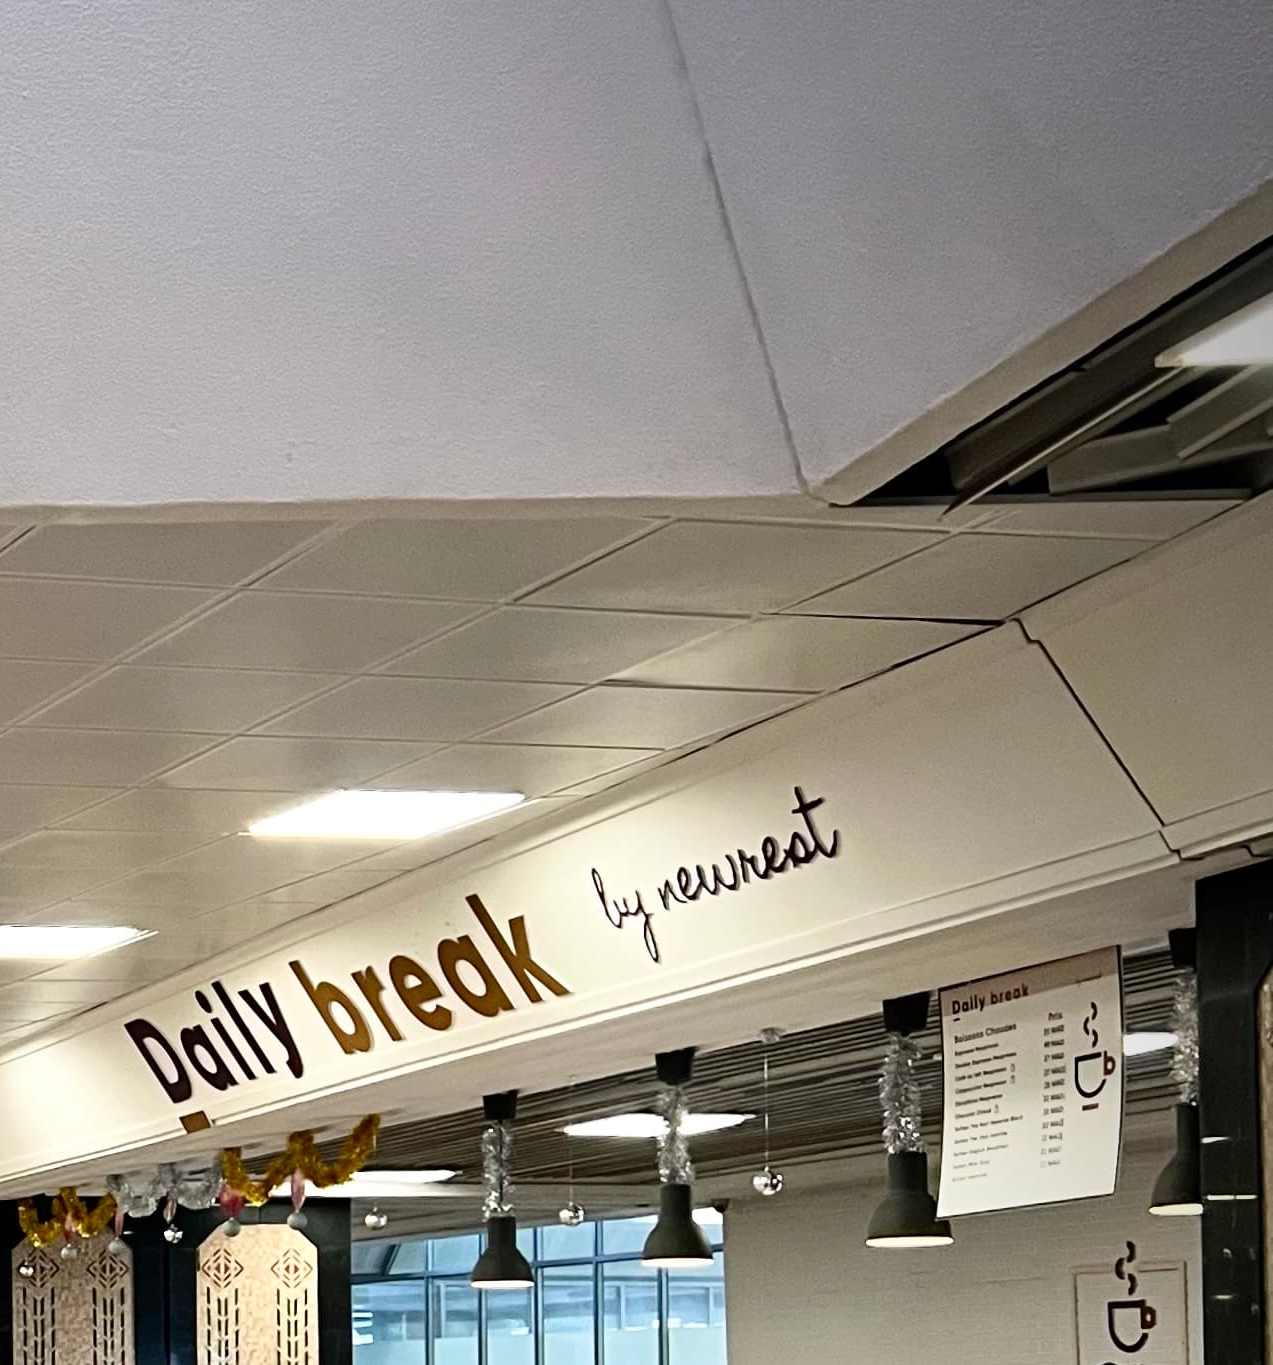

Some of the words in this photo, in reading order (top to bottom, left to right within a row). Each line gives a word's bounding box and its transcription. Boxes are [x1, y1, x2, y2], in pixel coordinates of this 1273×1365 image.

[591, 868, 661, 963] by
[658, 786, 842, 910] newrest
[124, 981, 305, 1104] Daily
[288, 893, 575, 1055] break
[951, 994, 986, 1015] Daily
[990, 982, 1030, 1005] break
